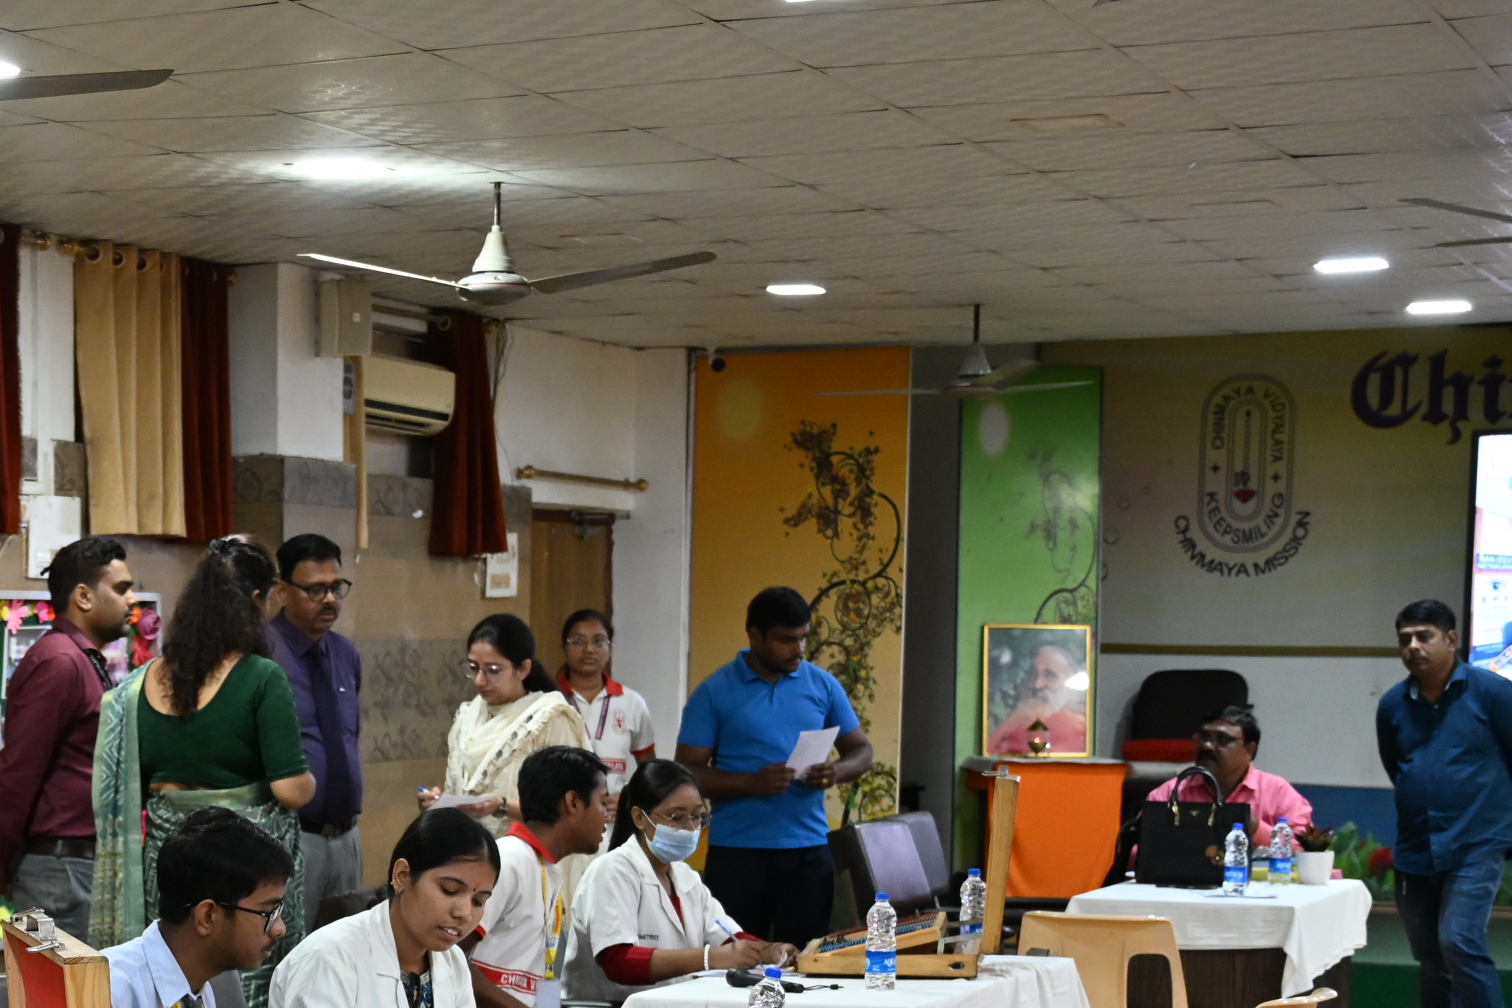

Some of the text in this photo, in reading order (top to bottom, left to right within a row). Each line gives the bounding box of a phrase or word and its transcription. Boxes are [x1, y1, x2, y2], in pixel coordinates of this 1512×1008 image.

[1211, 385, 1286, 464] CHINMAYA VIDYALAYA
[1350, 348, 1512, 444] Chi
[1174, 510, 1312, 577] CHINMAYA MISSION
